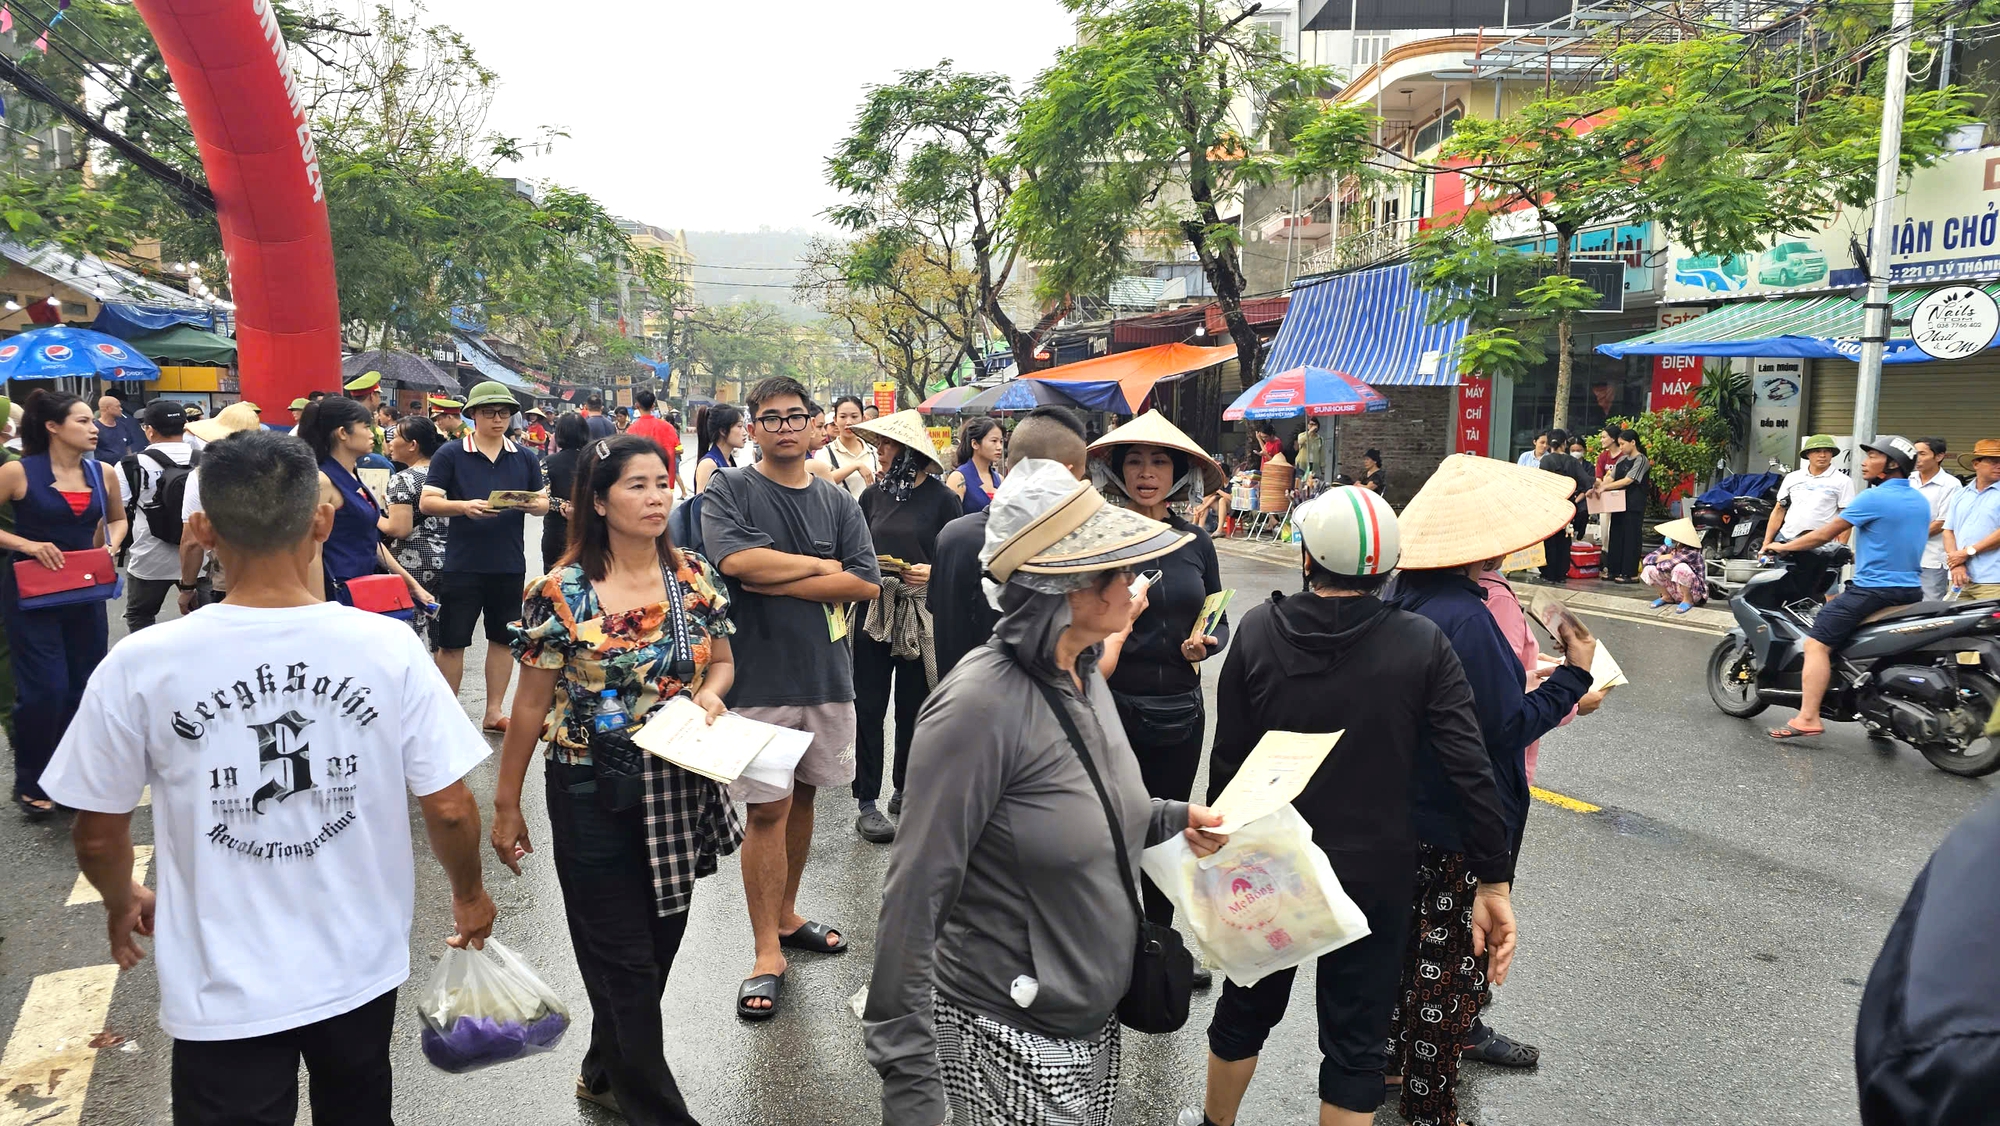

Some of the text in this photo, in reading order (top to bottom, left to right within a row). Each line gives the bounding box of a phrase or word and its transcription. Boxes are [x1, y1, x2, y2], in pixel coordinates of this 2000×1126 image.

[296, 122, 324, 203] 2024
[1943, 201, 1999, 250] CHỞ
[1901, 266, 1922, 279] 221
[1926, 264, 1933, 276] B
[1938, 260, 1954, 275] LÝ
[1926, 302, 1976, 321] Nails
[1465, 384, 1485, 398] MÁY
[1662, 378, 1692, 395] MÁY
[1313, 404, 1357, 413] SUNHOUSE
[1465, 406, 1482, 420] CHÍ
[1465, 427, 1480, 440] TÀI
[246, 709, 316, 815] S
